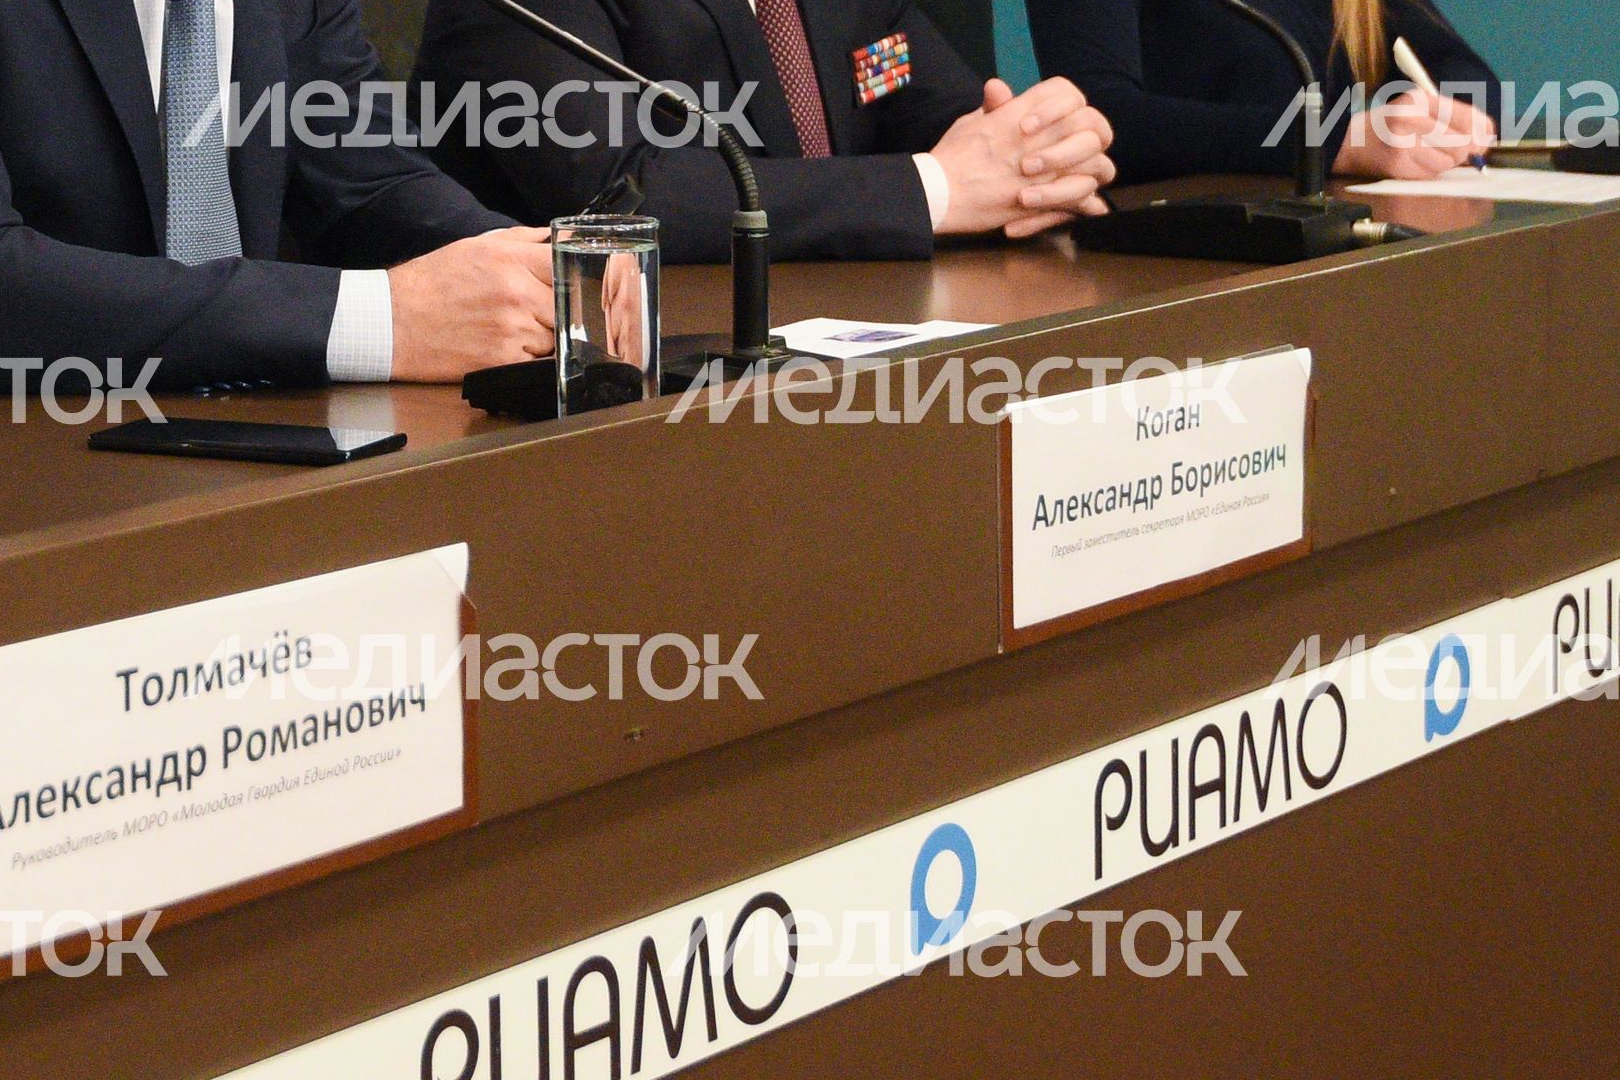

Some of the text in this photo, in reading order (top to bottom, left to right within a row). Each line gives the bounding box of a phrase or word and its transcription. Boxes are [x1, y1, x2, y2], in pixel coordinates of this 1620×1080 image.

[1136, 403, 1200, 441] Коган
[1032, 443, 1287, 531] Александр Борисович
[1051, 538, 1082, 558] Первый
[116, 630, 312, 712] Толмачёв
[222, 682, 426, 769] Романович
[12, 746, 402, 870] Руководитель МОРО «Молодая Гвардия Единой России»
